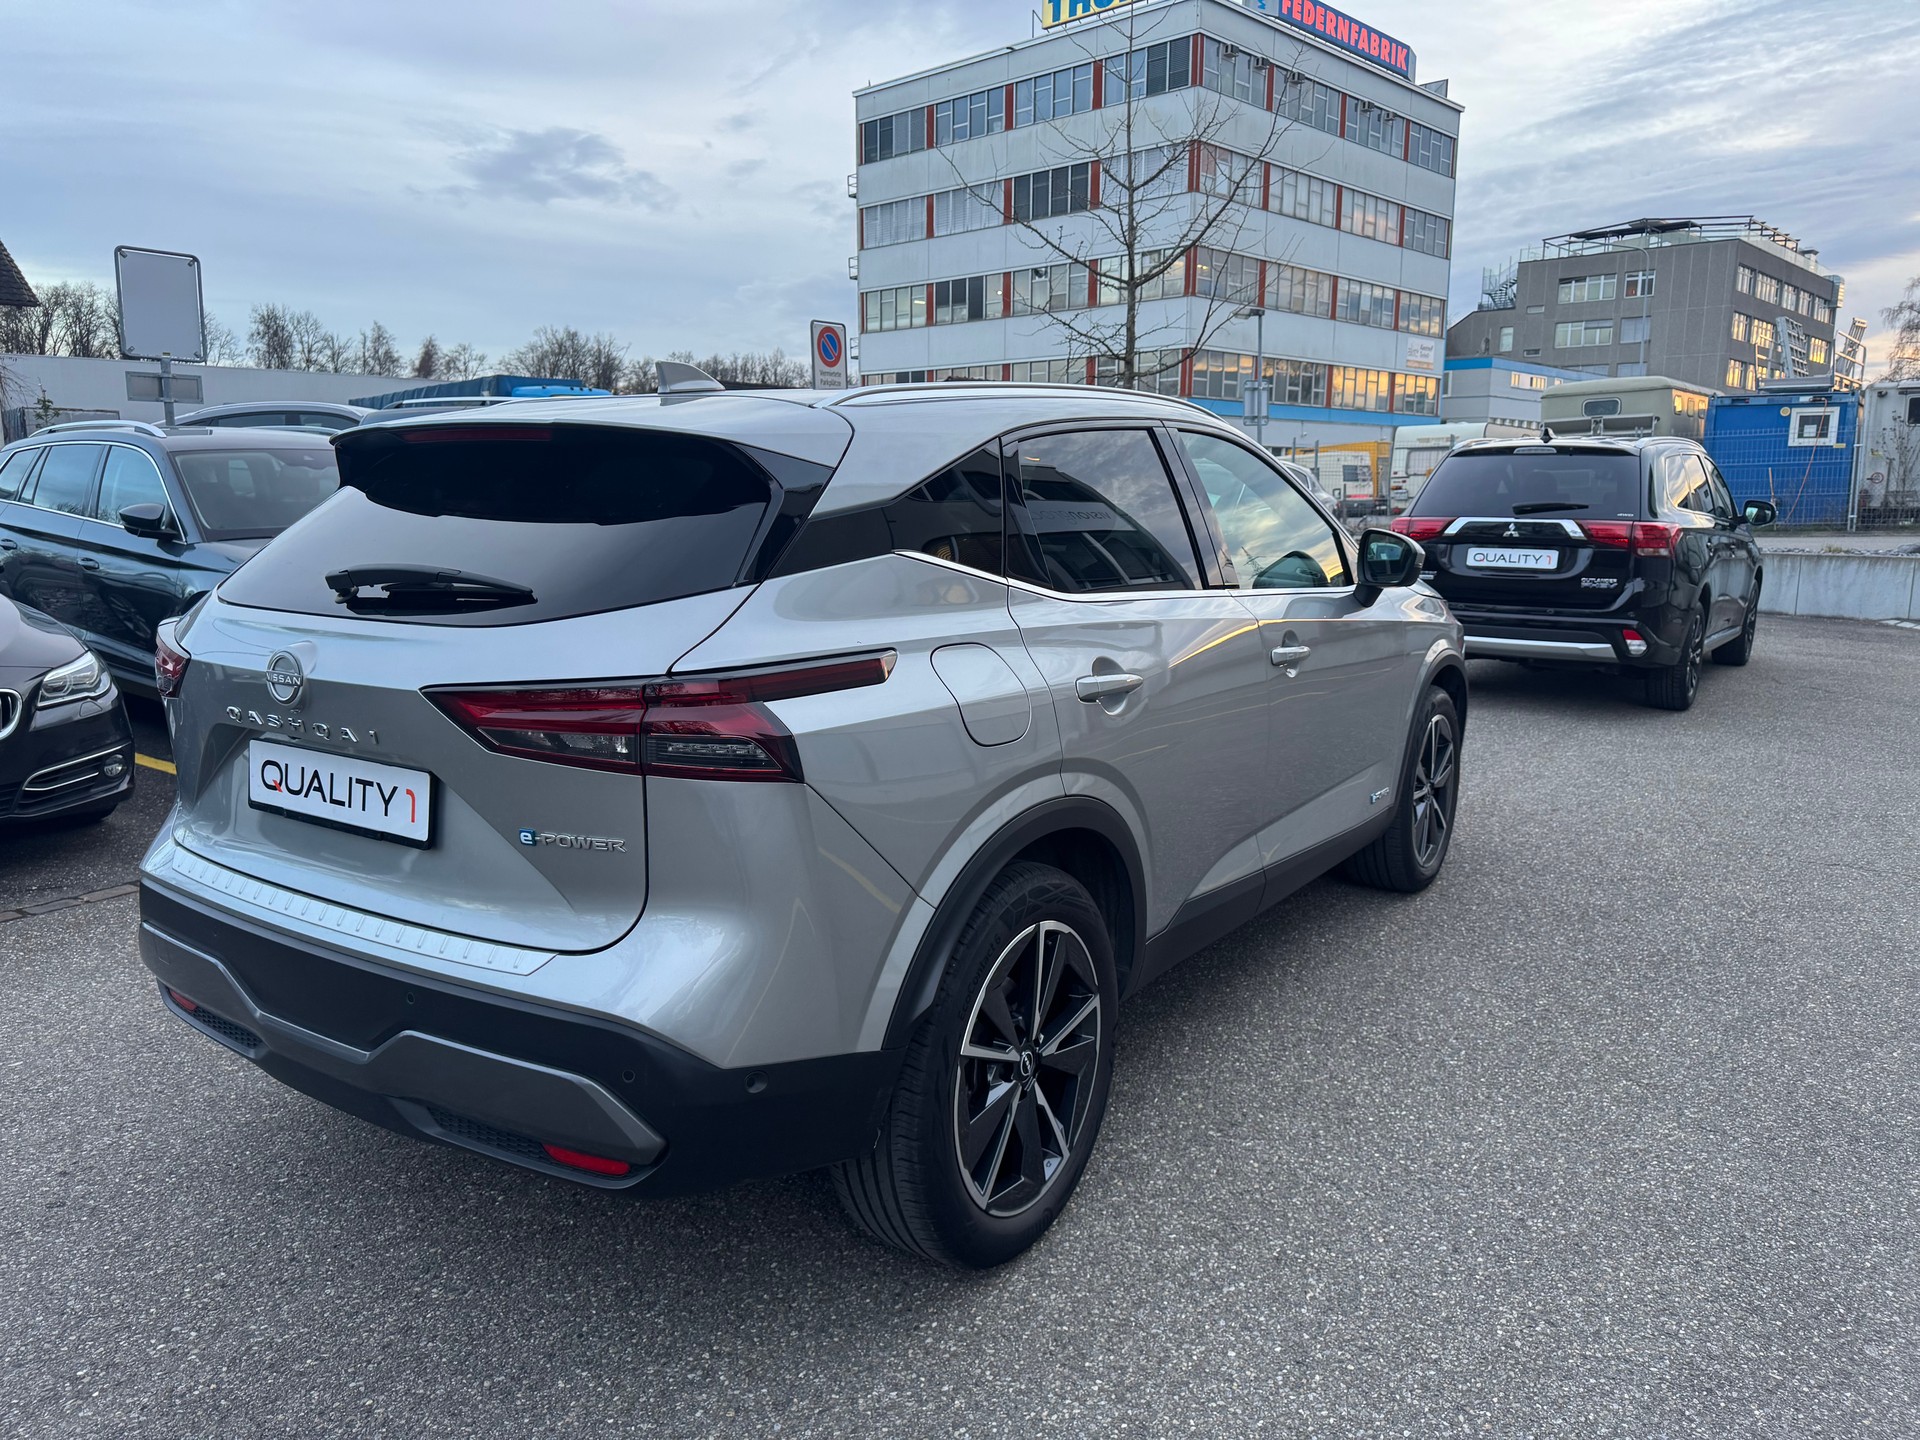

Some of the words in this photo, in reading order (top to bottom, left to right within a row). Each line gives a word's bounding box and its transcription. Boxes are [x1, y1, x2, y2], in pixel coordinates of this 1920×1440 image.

[1281, 0, 1407, 71] FEDERNFABRIK
[266, 670, 301, 684] NISSAN
[226, 704, 379, 745] QASHQAI
